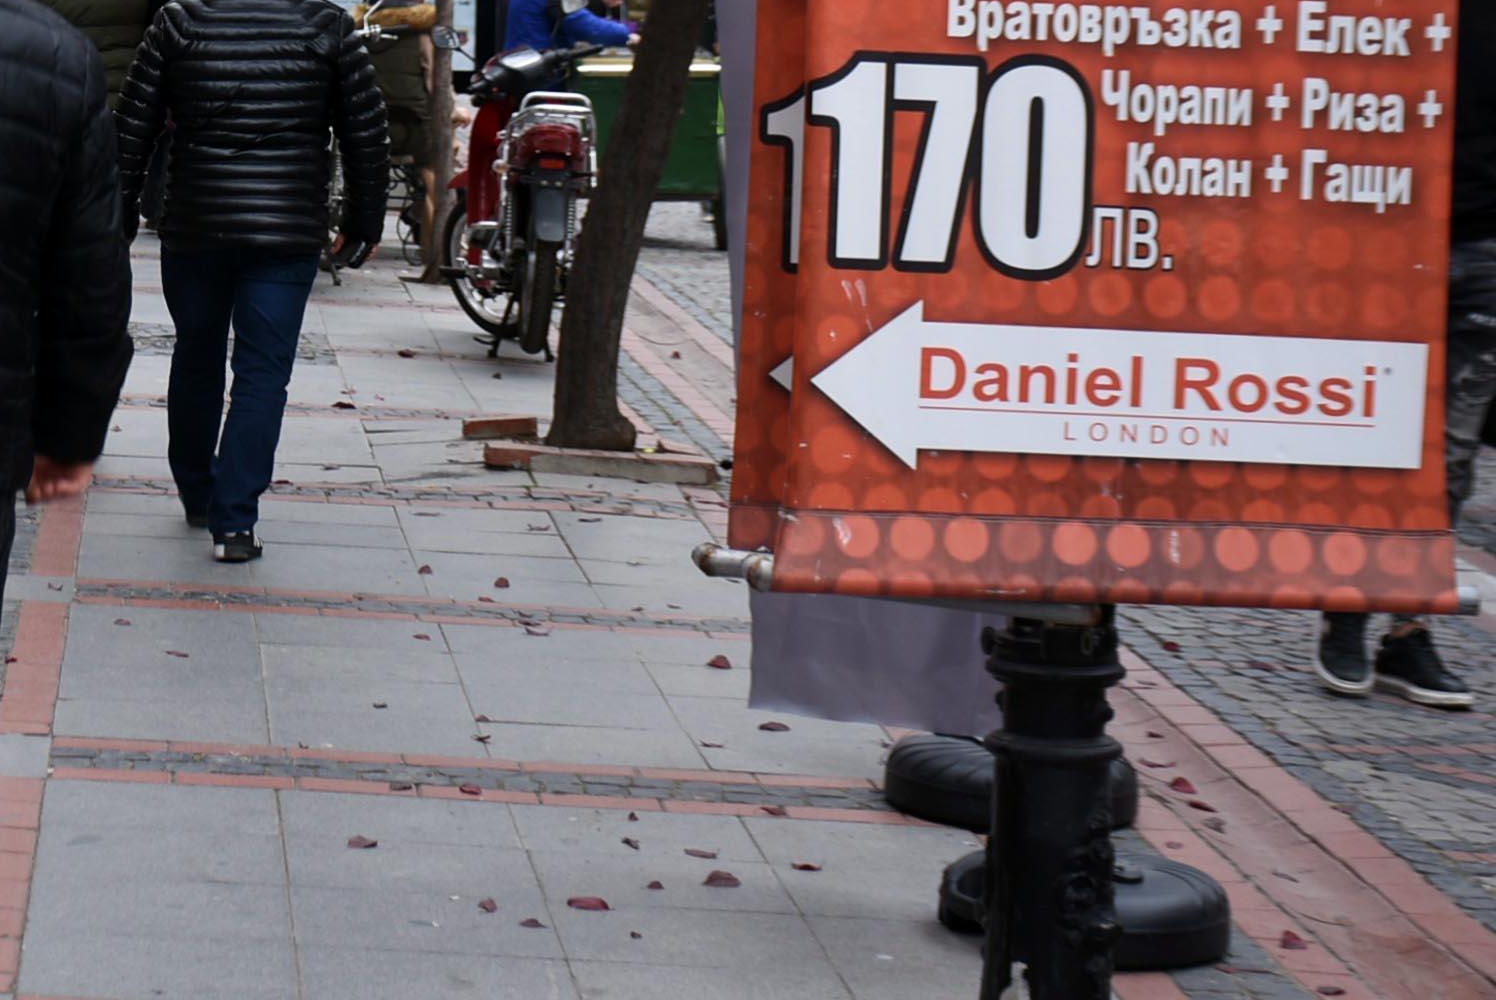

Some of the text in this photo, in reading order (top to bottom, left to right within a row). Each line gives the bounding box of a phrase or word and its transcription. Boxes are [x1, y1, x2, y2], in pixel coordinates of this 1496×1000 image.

[1297, 0, 1411, 56] Елек
[1101, 69, 1252, 137] Чорапи
[1302, 77, 1404, 133] Риза
[1126, 142, 1251, 198] Колан
[1301, 149, 1412, 213] Гащи
[920, 346, 1376, 418] Daniel Rossi
[1065, 417, 1230, 446] LONDON
